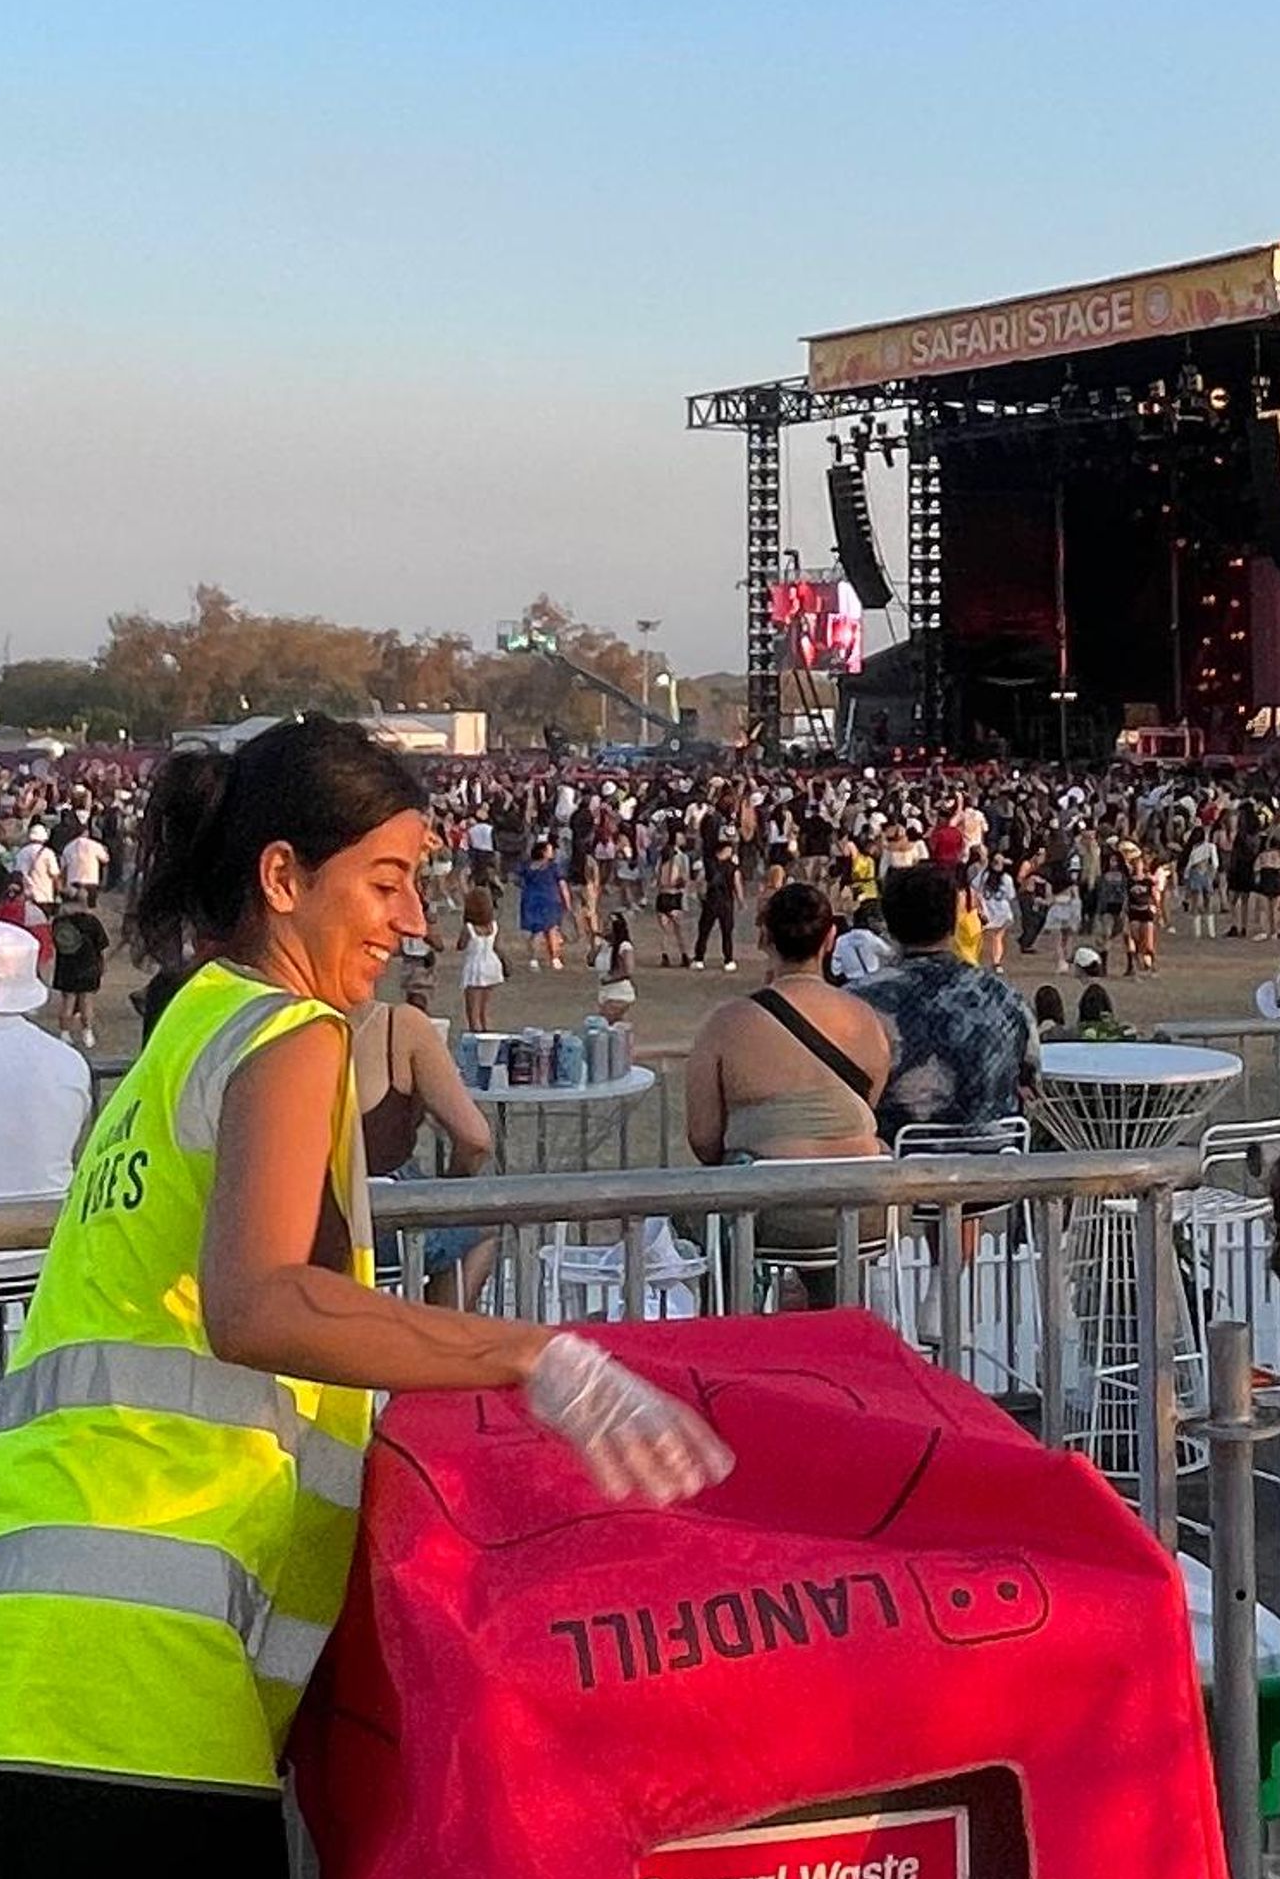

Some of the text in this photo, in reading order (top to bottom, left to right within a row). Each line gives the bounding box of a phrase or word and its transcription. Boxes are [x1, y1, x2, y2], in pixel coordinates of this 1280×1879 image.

[911, 290, 1133, 364] SAFARI STAGE
[550, 1572, 900, 1689] LANDFILL
